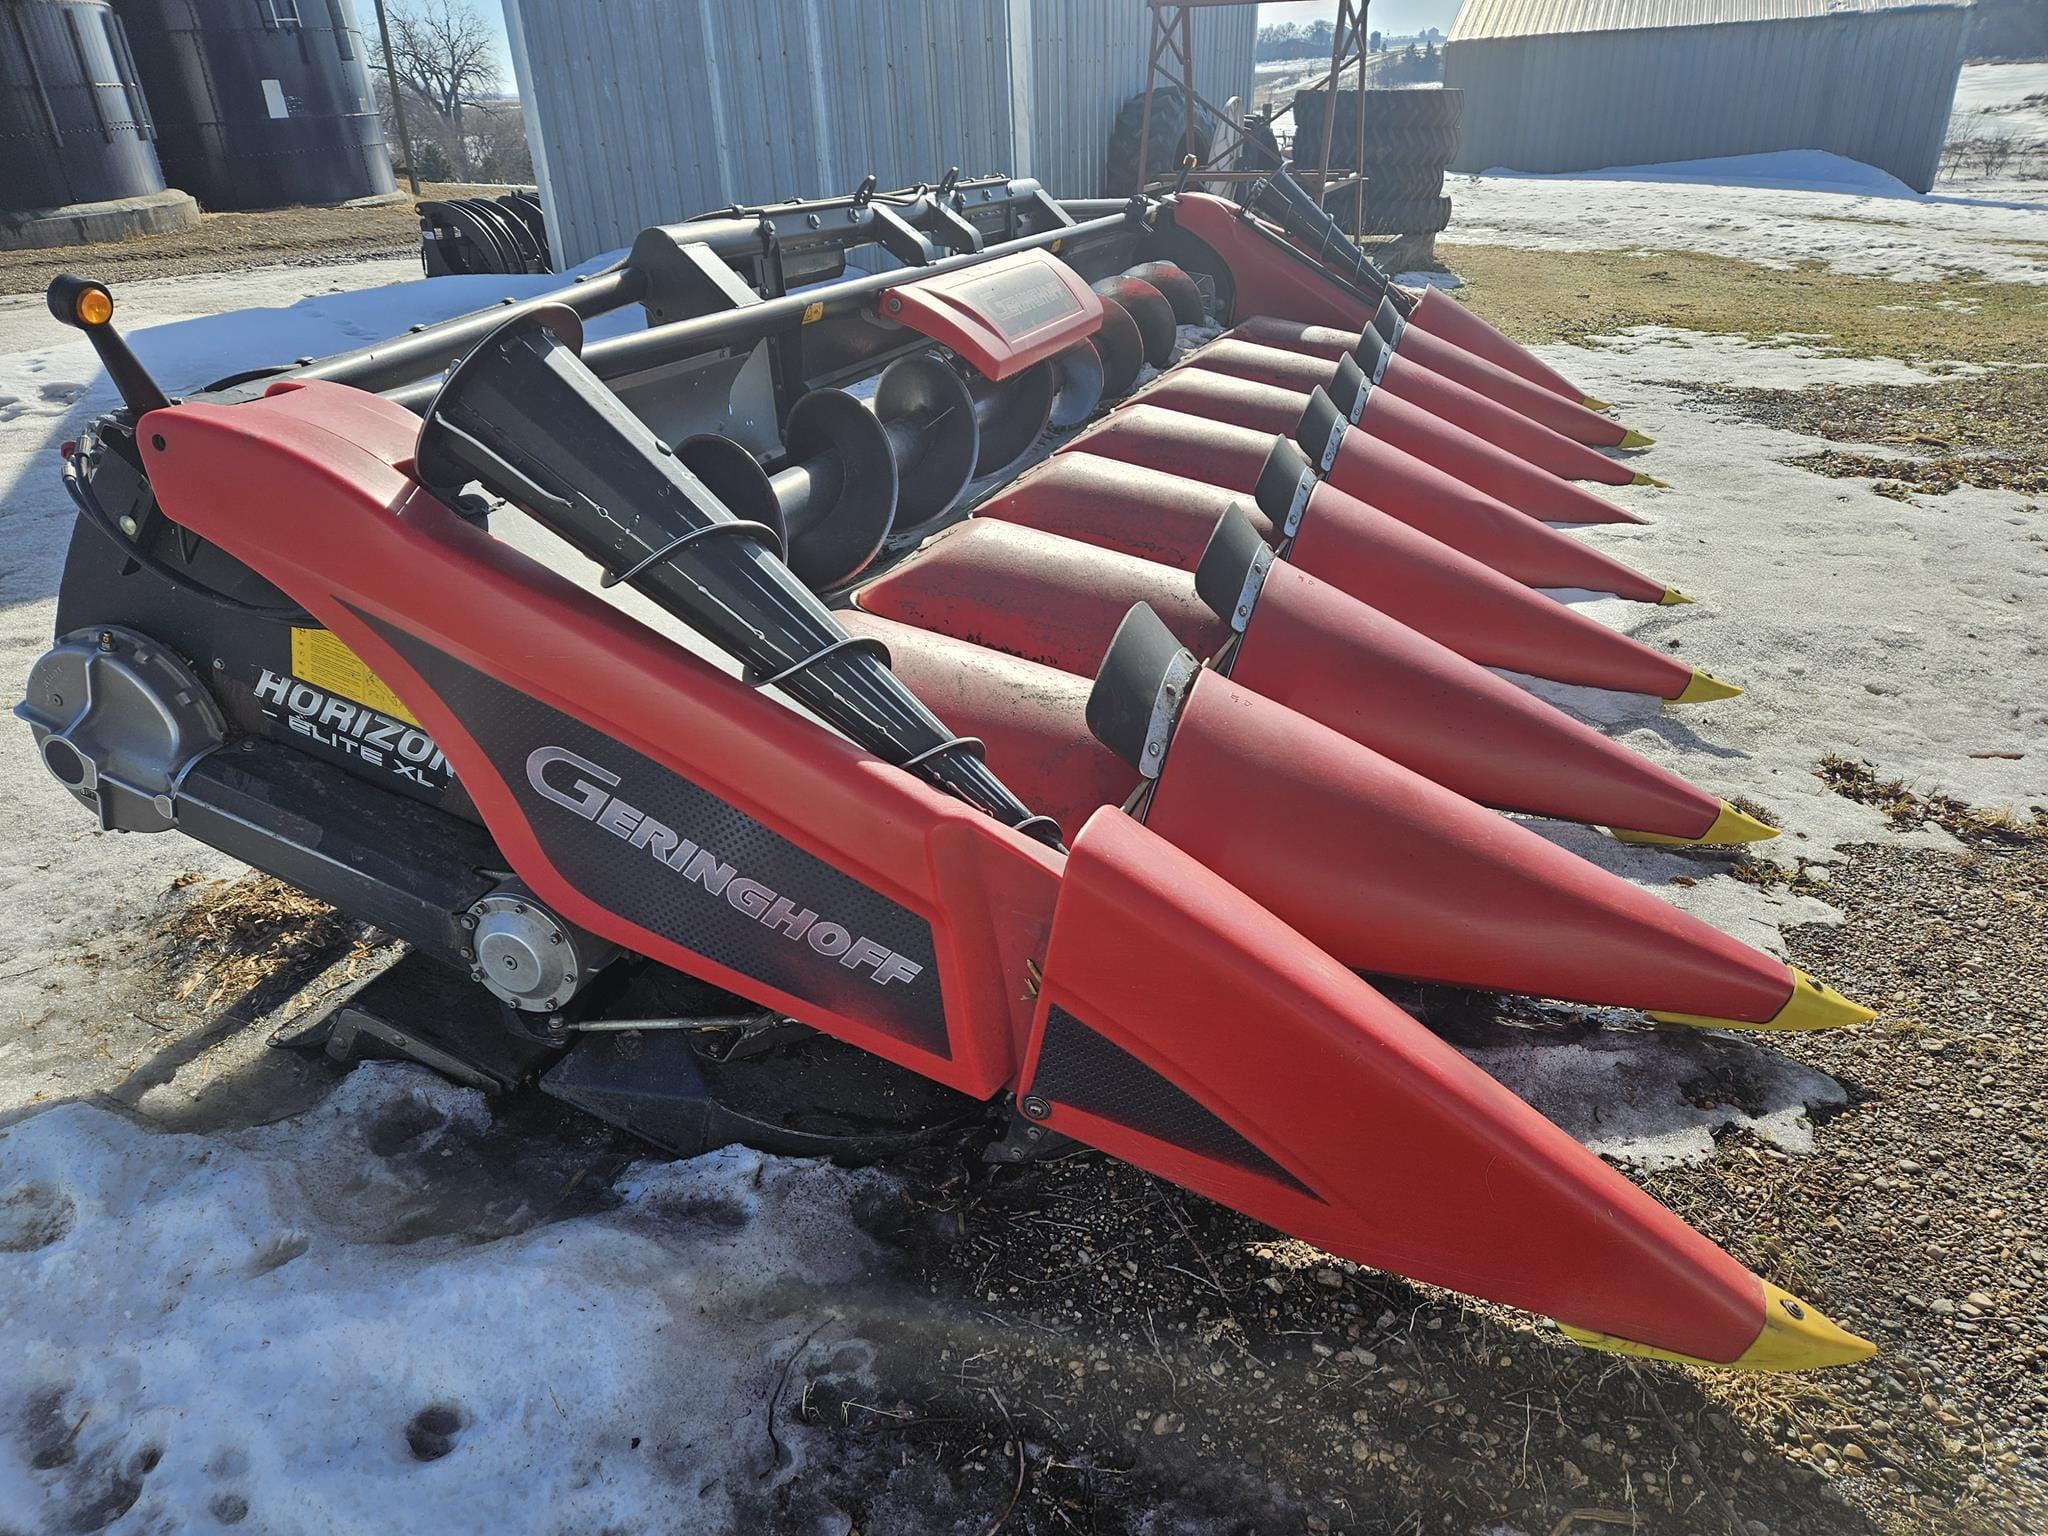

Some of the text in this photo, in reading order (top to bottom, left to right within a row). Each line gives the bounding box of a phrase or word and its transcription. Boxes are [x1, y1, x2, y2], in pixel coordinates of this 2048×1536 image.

[288, 714, 383, 767] ELITE
[393, 759, 434, 788] XL
[526, 746, 923, 985] GERINGHOFF
